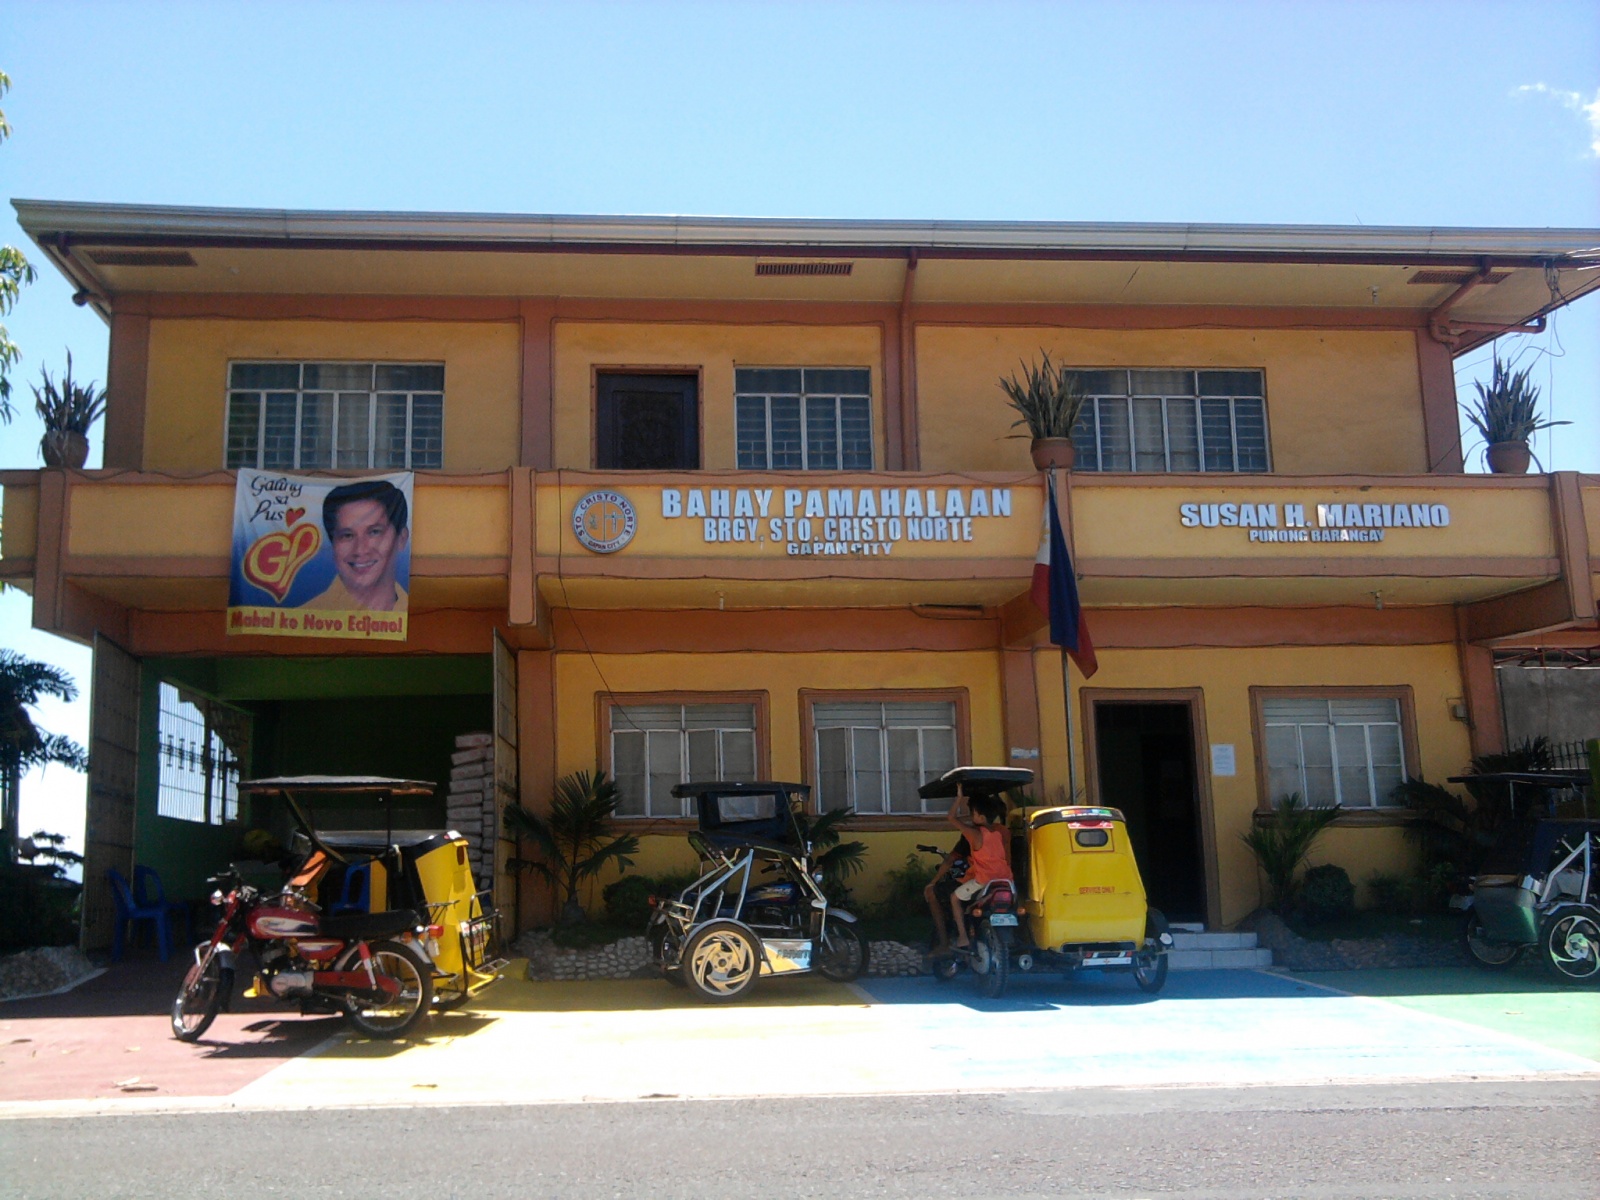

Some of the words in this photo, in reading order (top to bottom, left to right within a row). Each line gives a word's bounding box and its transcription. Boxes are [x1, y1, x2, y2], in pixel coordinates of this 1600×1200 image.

[251, 475, 303, 497] Galing
[580, 493, 618, 510] CRISTO
[620, 501, 634, 536] NORTE
[661, 489, 772, 518] BAHAY
[784, 489, 1012, 518] PAMAHALAAN
[1180, 503, 1278, 528] SUSAN
[1284, 504, 1312, 528] H.
[1317, 503, 1450, 528] MARIANO
[703, 517, 765, 542] BRGY.
[770, 517, 820, 542] STO.
[823, 517, 902, 542] CRISTO
[906, 517, 973, 541] NORTE
[1249, 529, 1309, 542] PUNONG
[1311, 529, 1386, 543] BARANGAY
[786, 542, 848, 556] GAPAN
[850, 542, 894, 556] CITY
[230, 610, 276, 629] Mahal
[279, 612, 298, 630] ko
[303, 613, 344, 632] Novo
